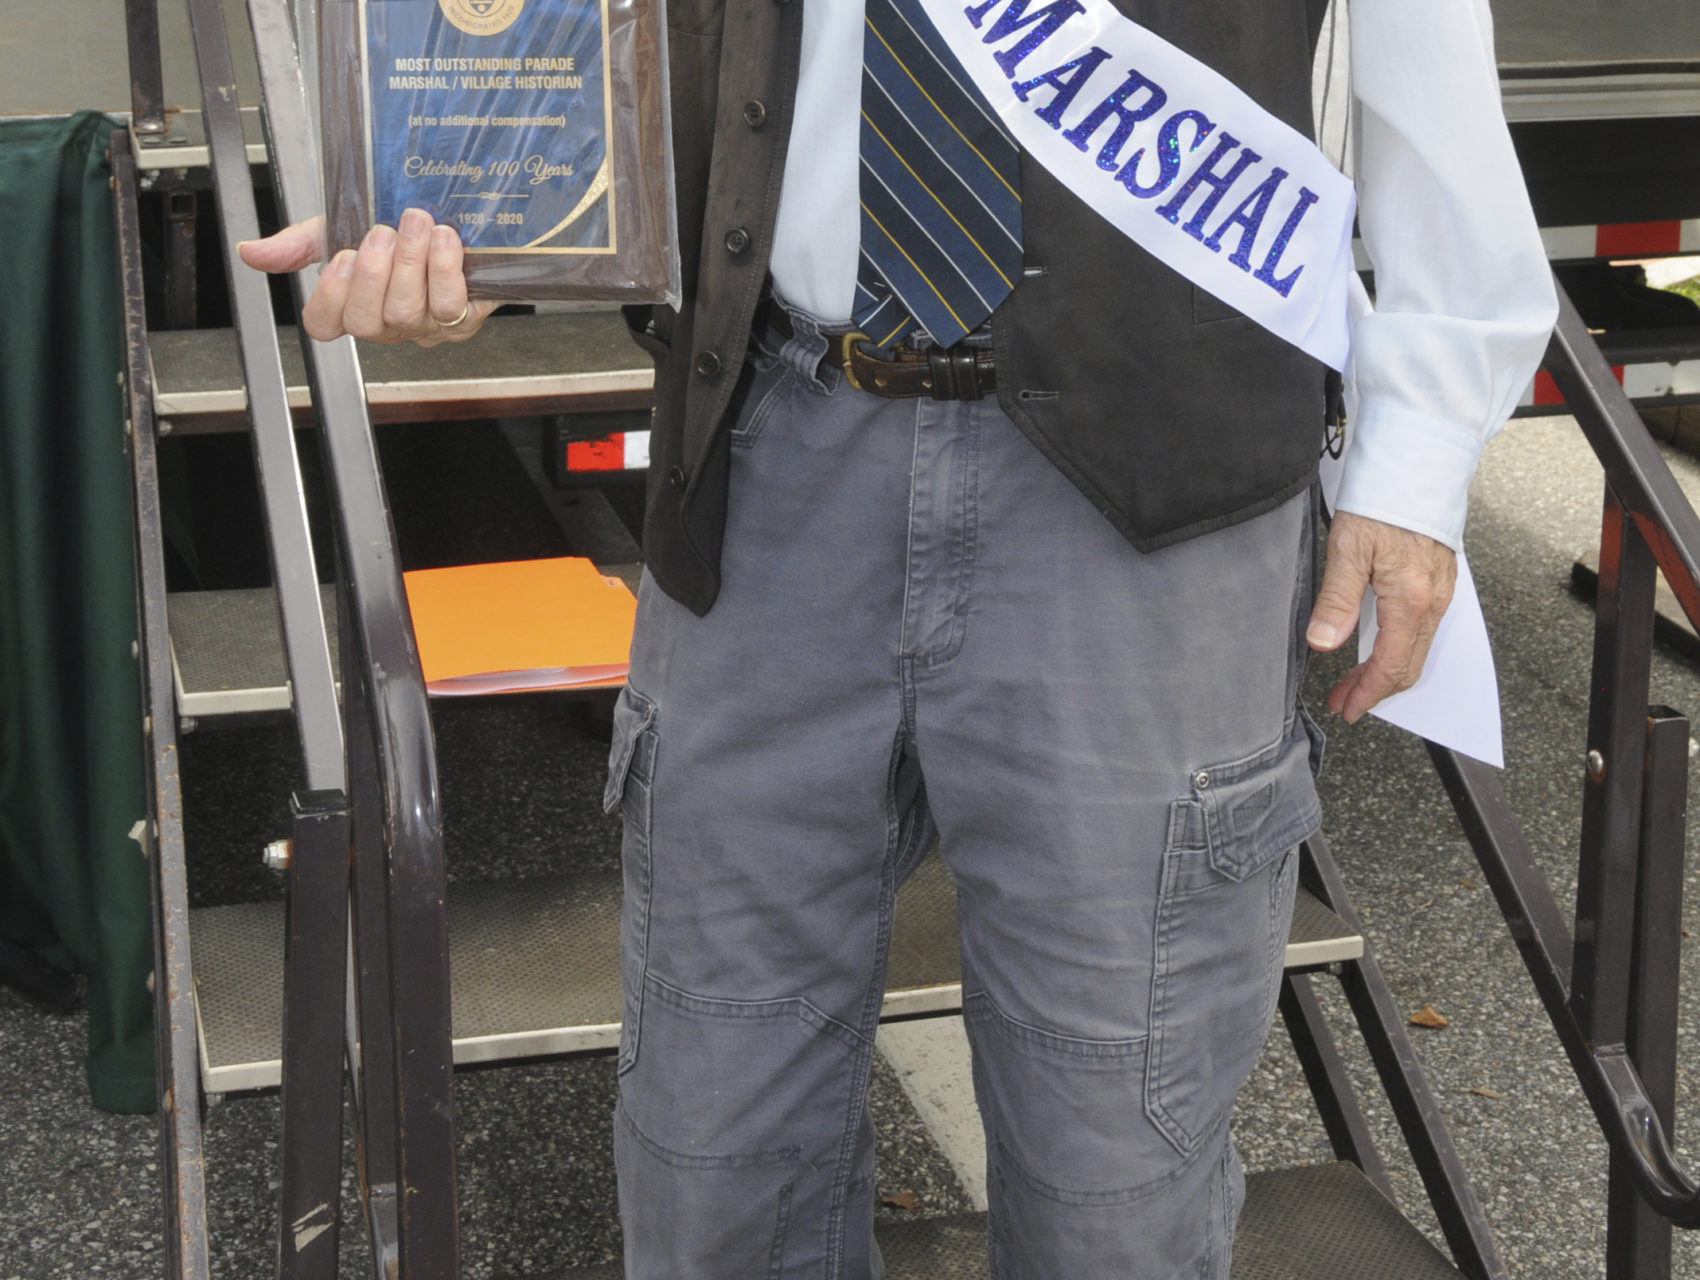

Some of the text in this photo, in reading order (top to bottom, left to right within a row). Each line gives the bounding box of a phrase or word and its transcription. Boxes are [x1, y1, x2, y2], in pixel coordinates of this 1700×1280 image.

[448, 6, 503, 29] INCOORATED
[395, 57, 575, 71] MOST OUTSTANDING PARADE
[389, 76, 449, 90] MARSHAL
[460, 76, 512, 90] VILLAGE
[515, 76, 582, 90] HISTORIAN
[408, 114, 566, 128] (at no additional compensation)
[404, 154, 575, 185] Celebrating 100 Years
[458, 213, 485, 225] 1920
[496, 213, 523, 225] 2020
